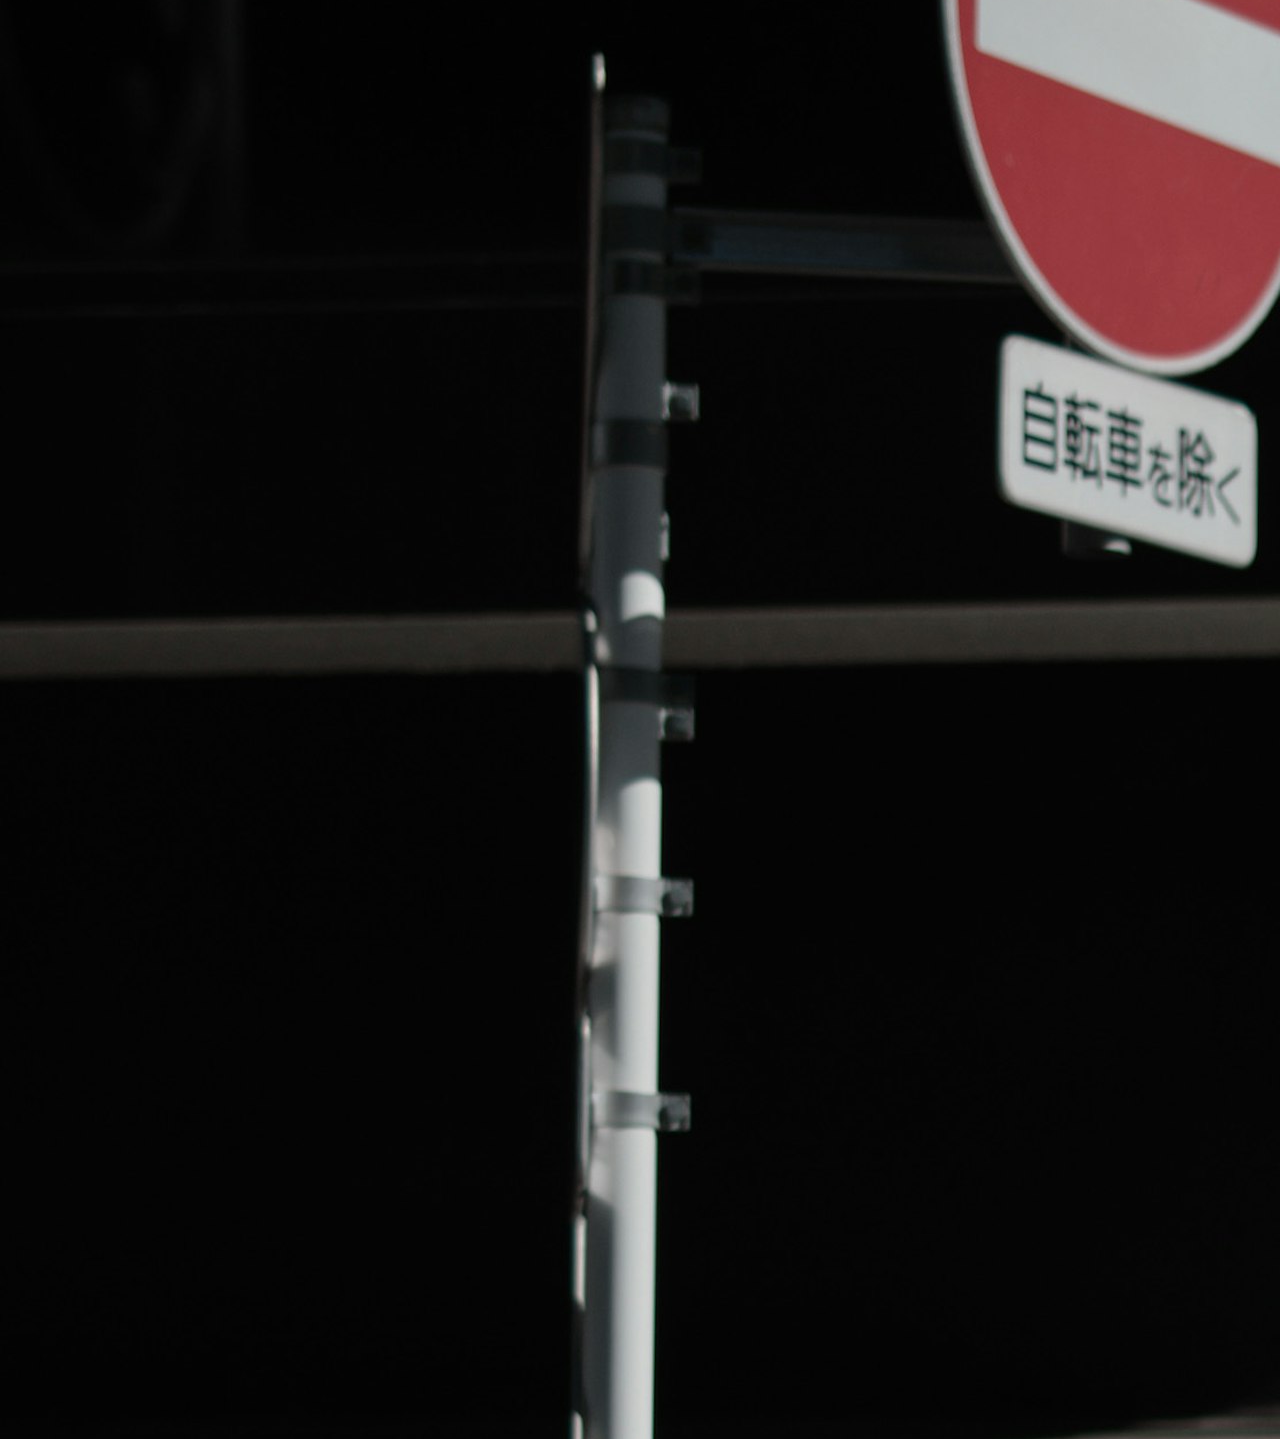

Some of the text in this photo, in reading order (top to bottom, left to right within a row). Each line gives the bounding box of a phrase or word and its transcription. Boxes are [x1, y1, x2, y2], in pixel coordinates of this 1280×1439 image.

[1023, 382, 1242, 526] 自転車を除く
